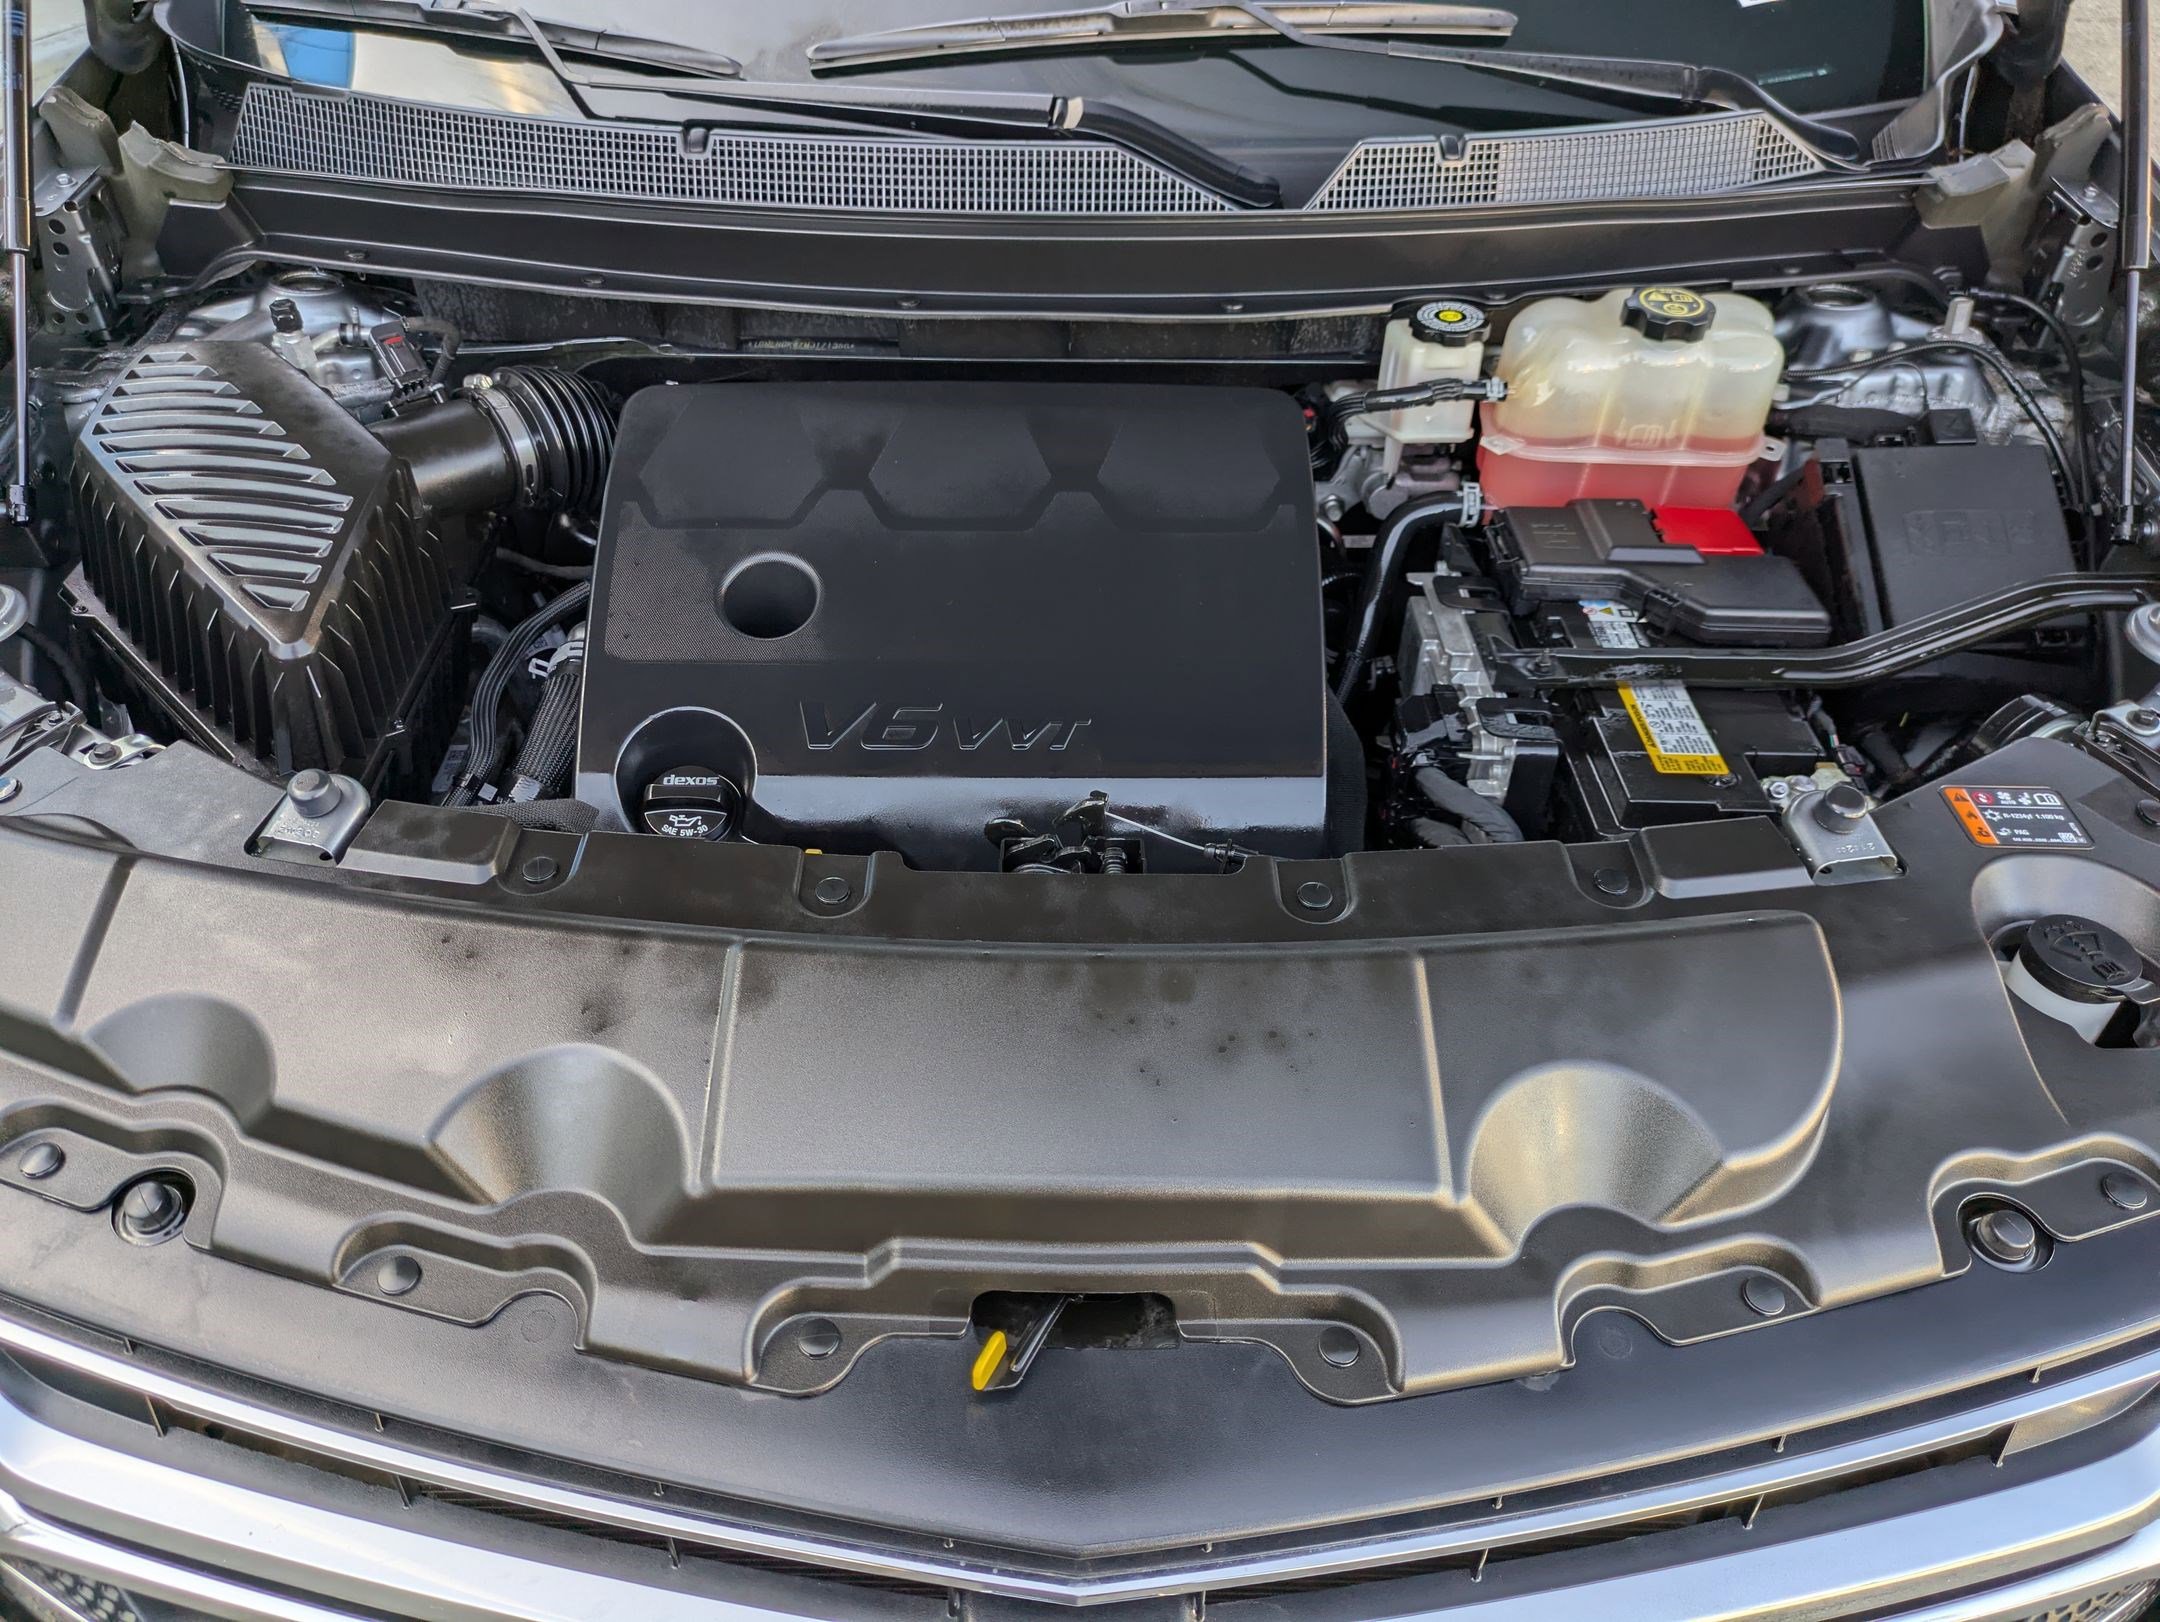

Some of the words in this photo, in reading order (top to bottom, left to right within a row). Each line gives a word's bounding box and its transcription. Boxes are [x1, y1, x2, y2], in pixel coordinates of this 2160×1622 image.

[799, 700, 944, 751] V6
[953, 717, 1093, 751] VVT
[662, 774, 720, 786] dexos
[661, 824, 679, 836] SAE
[679, 824, 709, 837] 5W-30
